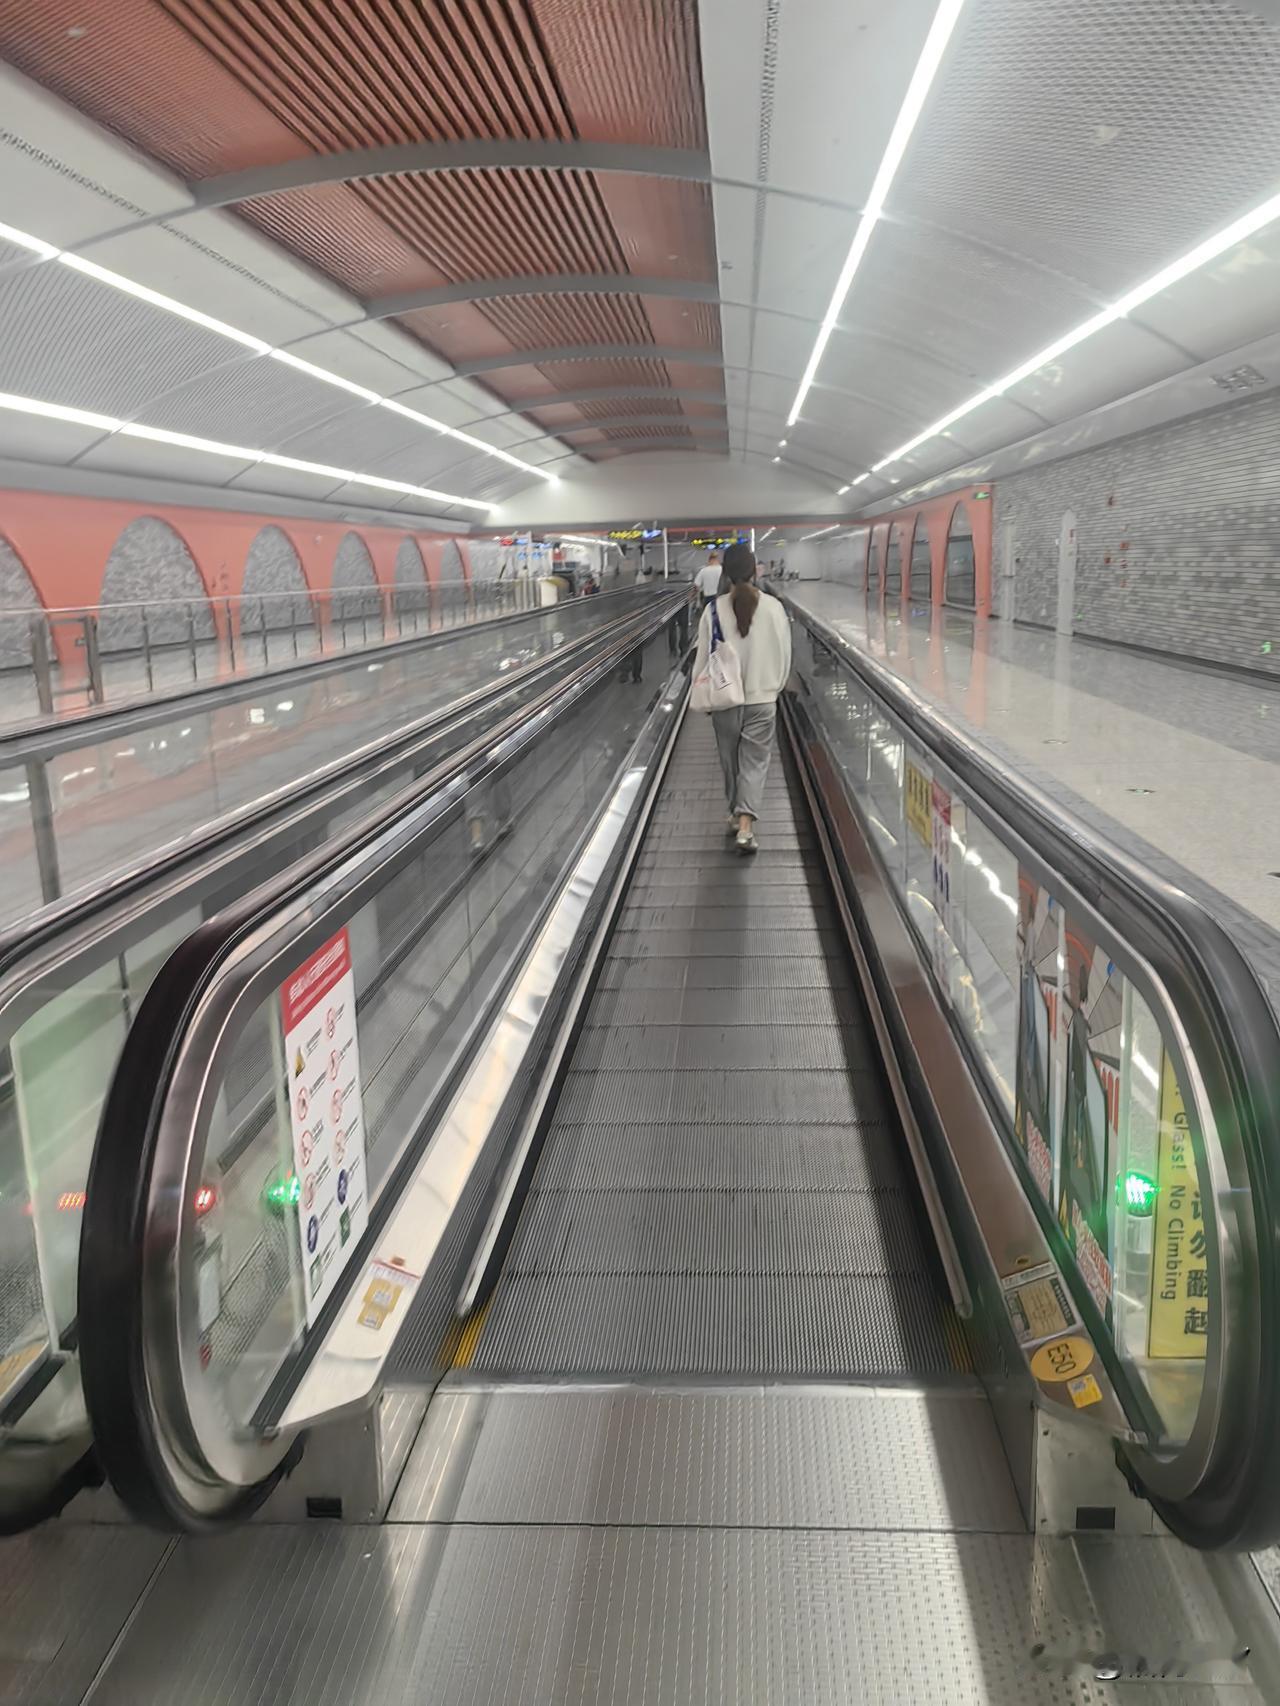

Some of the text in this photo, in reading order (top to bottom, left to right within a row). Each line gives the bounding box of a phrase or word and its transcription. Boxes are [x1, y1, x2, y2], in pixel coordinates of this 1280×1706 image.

[1171, 1112, 1189, 1171] Glass!
[1169, 1185, 1186, 1210] No
[1161, 1218, 1184, 1301] Climbing
[1048, 1343, 1077, 1375] E50
